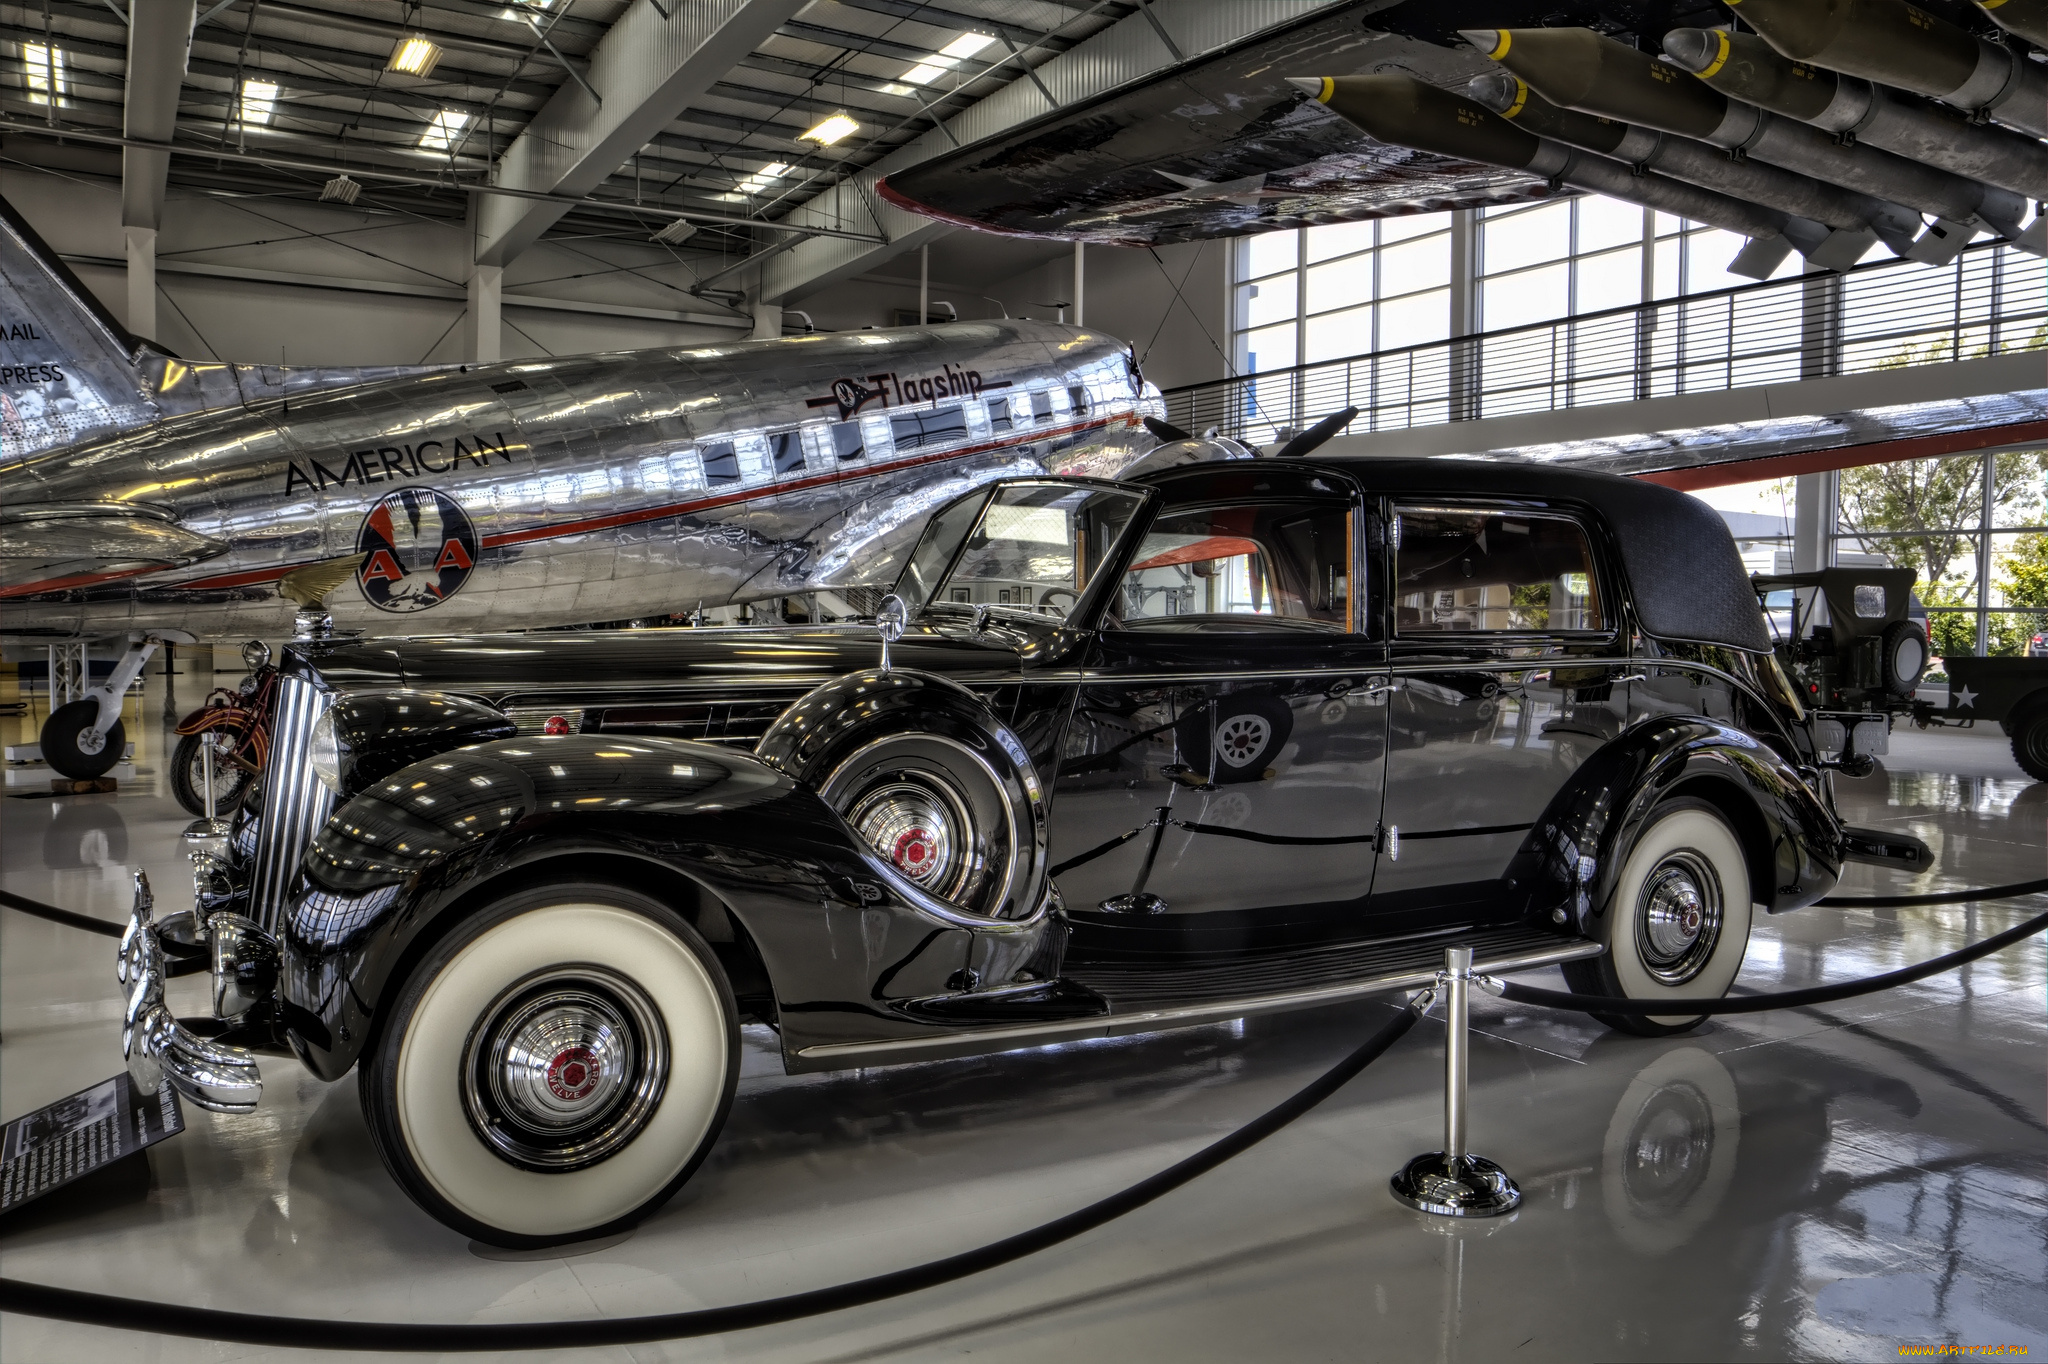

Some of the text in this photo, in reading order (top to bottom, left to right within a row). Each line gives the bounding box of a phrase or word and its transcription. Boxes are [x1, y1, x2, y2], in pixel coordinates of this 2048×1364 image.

[868, 363, 983, 409] Flagship
[285, 432, 512, 497] AMERICAN
[900, 858, 935, 875] TWELVE
[550, 1066, 581, 1099] TWELVE
